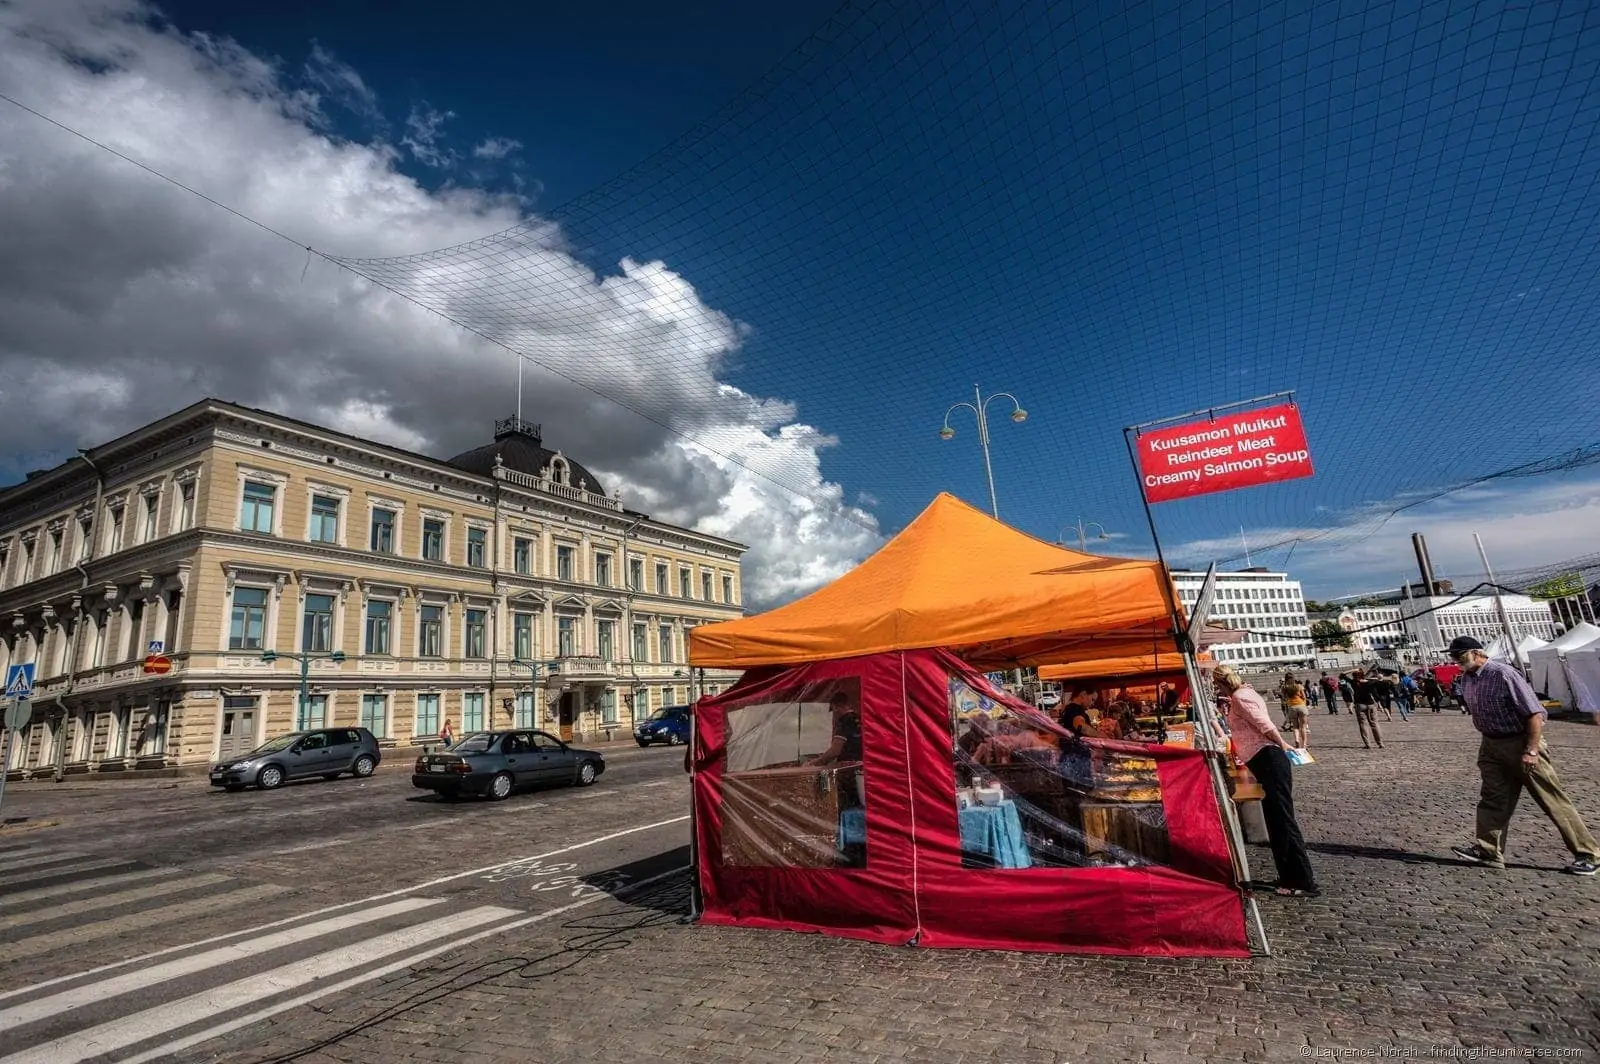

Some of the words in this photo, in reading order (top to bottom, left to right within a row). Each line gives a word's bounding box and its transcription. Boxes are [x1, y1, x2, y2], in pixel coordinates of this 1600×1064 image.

[1150, 427, 1230, 452] Kuusamon
[1233, 415, 1287, 436] Muikut
[1167, 443, 1234, 466] Reindeer
[1237, 436, 1276, 453] Meat
[1145, 468, 1202, 488] Creamy
[1204, 456, 1263, 477] Salmon
[1265, 449, 1308, 466] Soup
